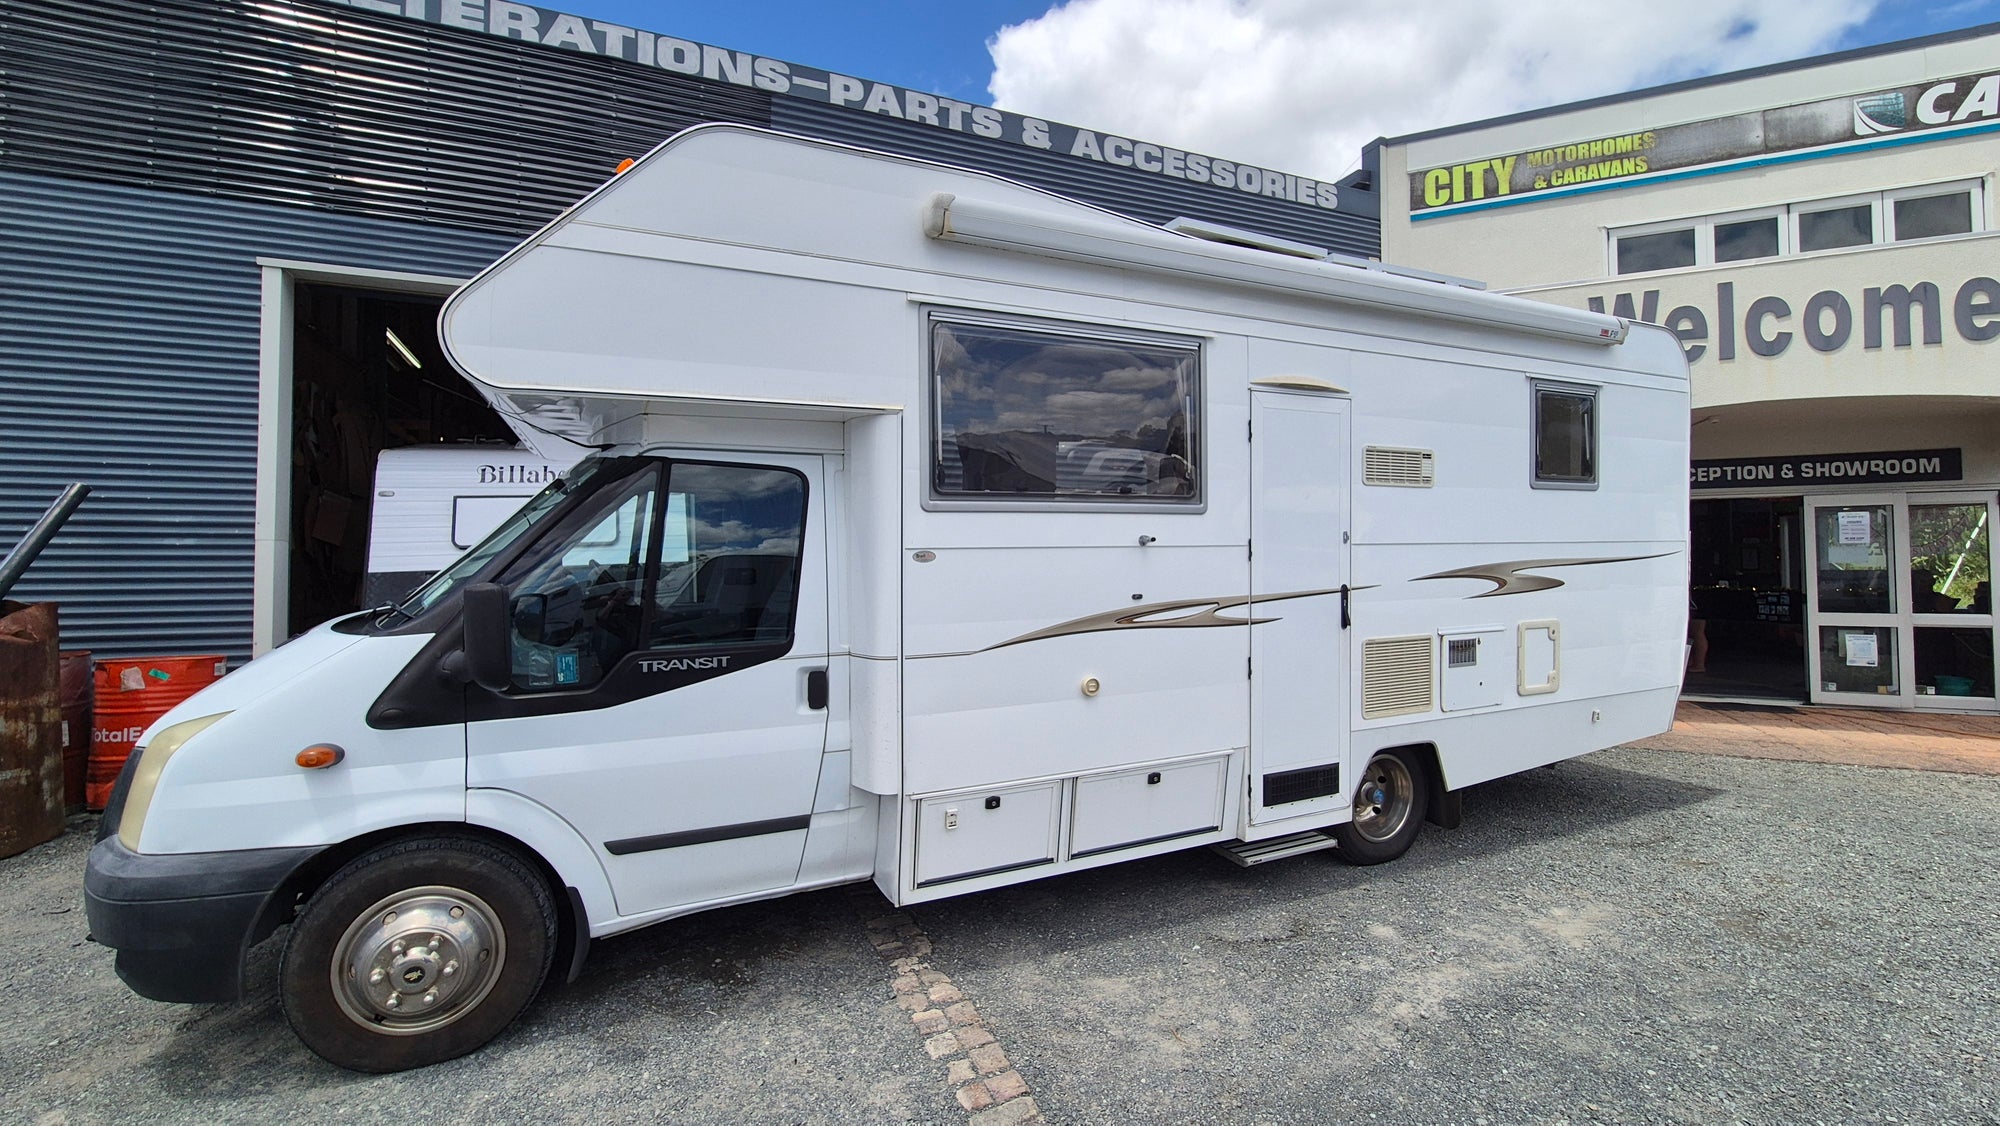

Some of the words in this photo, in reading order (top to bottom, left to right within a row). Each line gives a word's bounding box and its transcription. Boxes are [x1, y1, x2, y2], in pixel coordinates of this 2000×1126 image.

[1916, 74, 2000, 125] CA
[1022, 116, 1052, 150] &
[1070, 129, 1339, 209] ACCESSORIES
[1526, 132, 1656, 169] MOTORHOMES
[1424, 155, 1518, 207] CITY
[1533, 174, 1548, 190] &
[1551, 155, 1648, 187] CARAVANS
[1780, 463, 1794, 479] &
[638, 655, 731, 673] TRANSIT
[91, 726, 145, 743] TotalE
